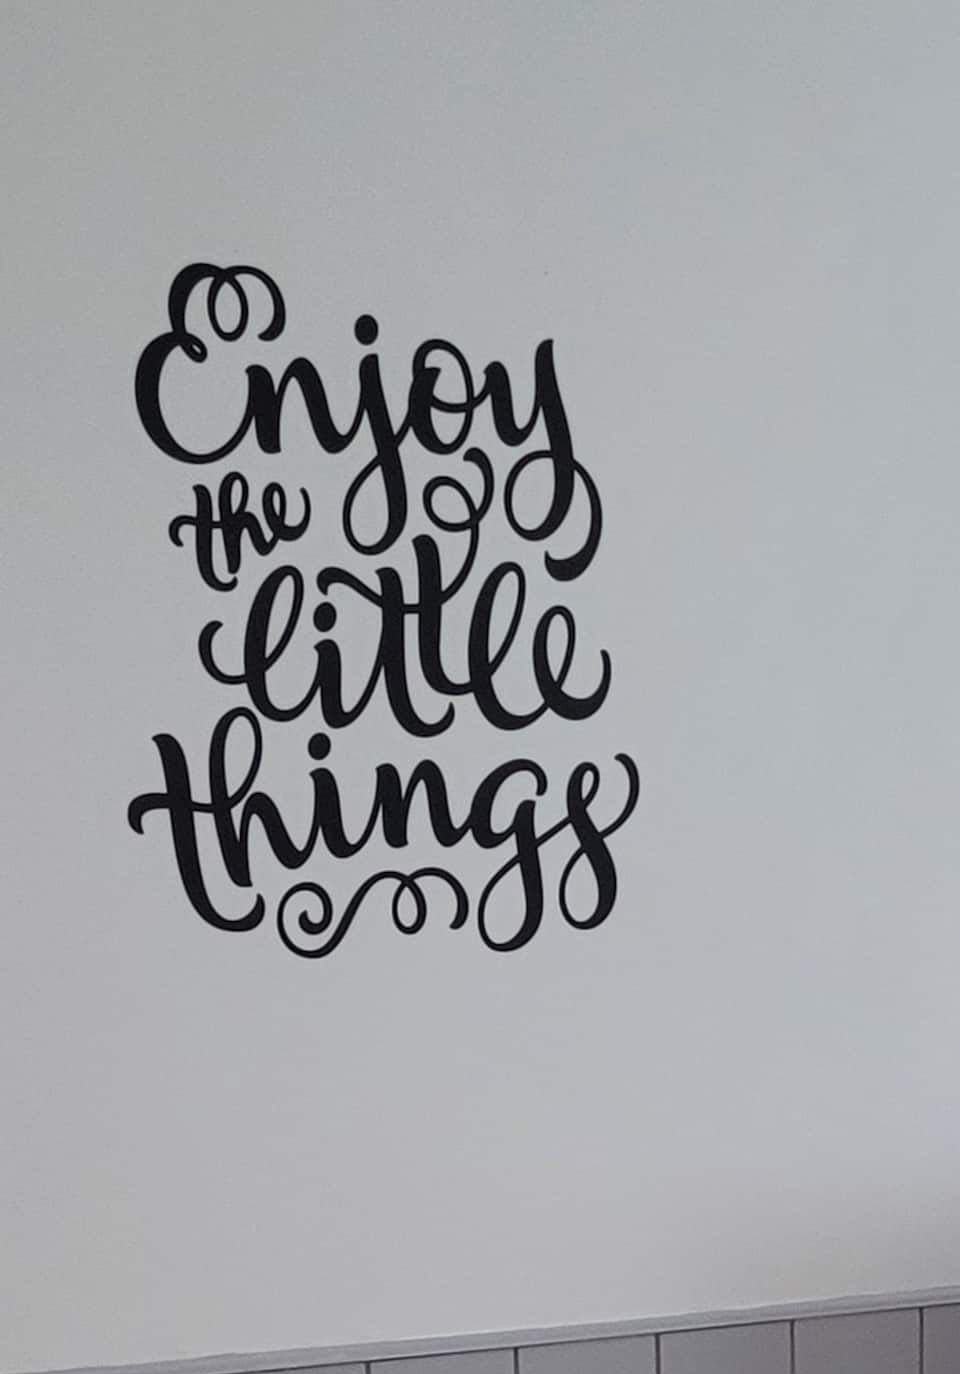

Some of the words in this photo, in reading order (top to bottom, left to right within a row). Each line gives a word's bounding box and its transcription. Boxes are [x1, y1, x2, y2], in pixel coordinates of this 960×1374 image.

[135, 263, 603, 582] Enjoy
[169, 472, 311, 593] the
[199, 448, 612, 738] little
[128, 707, 640, 953] things
